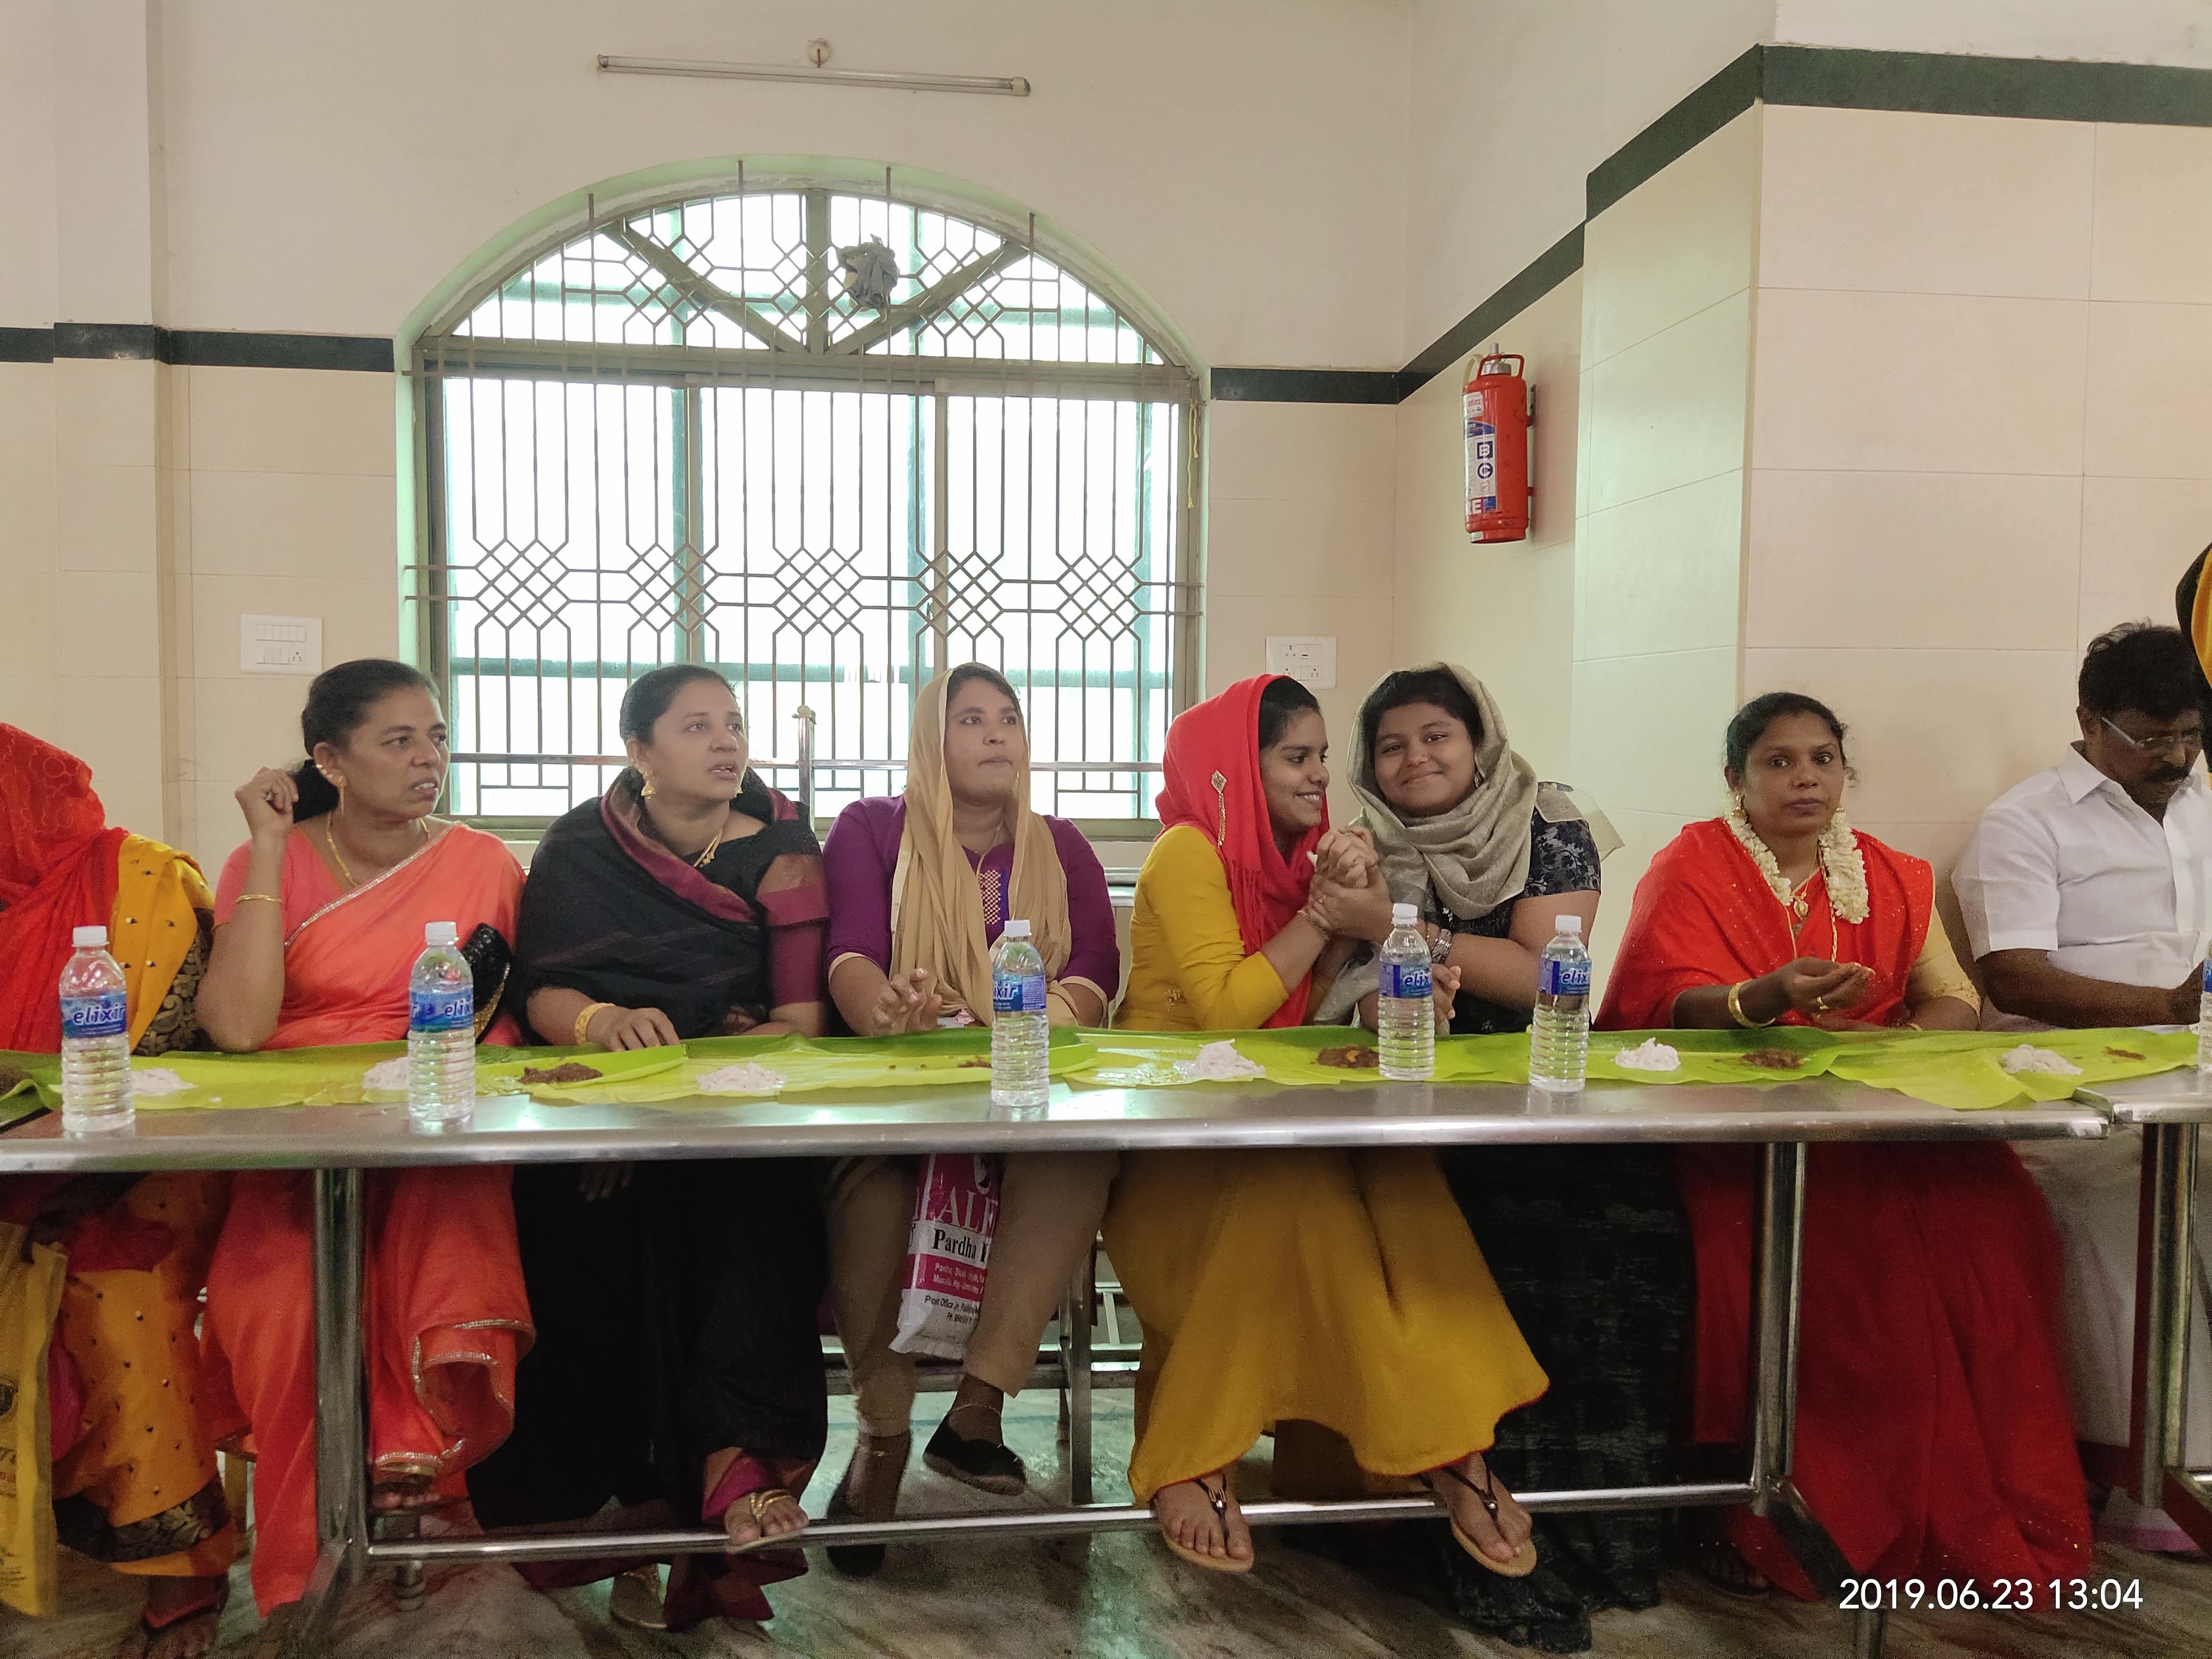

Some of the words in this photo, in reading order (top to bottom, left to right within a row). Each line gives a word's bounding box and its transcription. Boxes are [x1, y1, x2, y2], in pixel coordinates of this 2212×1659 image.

[1478, 442, 1491, 458] B
[1403, 969, 1431, 987] elix
[1562, 968, 1591, 985] elix
[993, 981, 1018, 1001] ixir
[73, 1002, 125, 1025] elixir
[444, 998, 472, 1018] elix
[932, 1228, 977, 1260] Pardha
